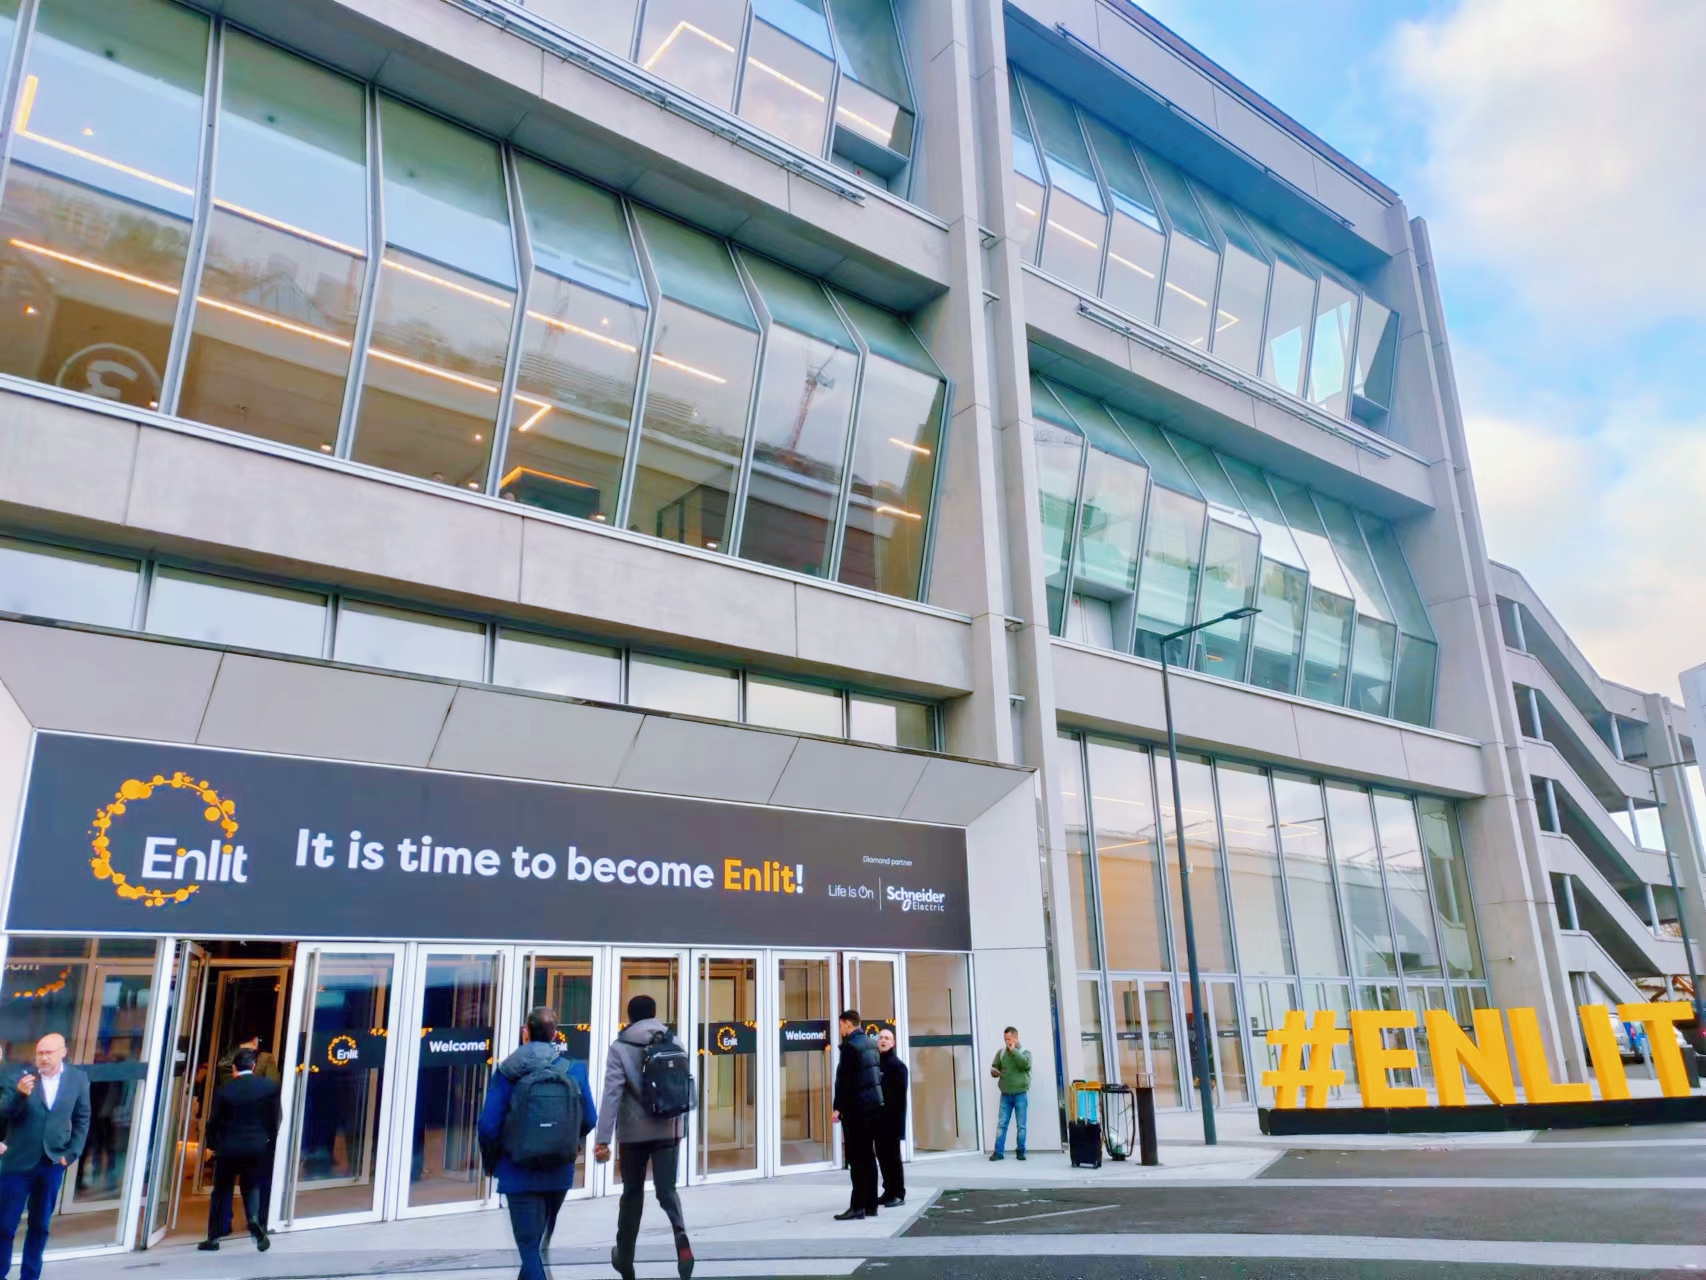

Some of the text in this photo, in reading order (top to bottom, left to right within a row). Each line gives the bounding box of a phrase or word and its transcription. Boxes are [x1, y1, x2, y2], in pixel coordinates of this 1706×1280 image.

[141, 835, 249, 883] Enlit
[295, 828, 804, 895] It is time to become Enlit!
[862, 855, 913, 867] Diamond partner
[828, 884, 847, 898] Life
[848, 885, 857, 898] Is
[886, 885, 946, 903] Schneider
[912, 901, 945, 912] Electric
[723, 1037, 737, 1046] Enlit
[785, 1030, 826, 1041] Welcome!
[429, 1039, 490, 1053] Welcome!
[336, 1049, 358, 1060] Enlit
[1261, 1001, 1695, 1110] #ENLIT
